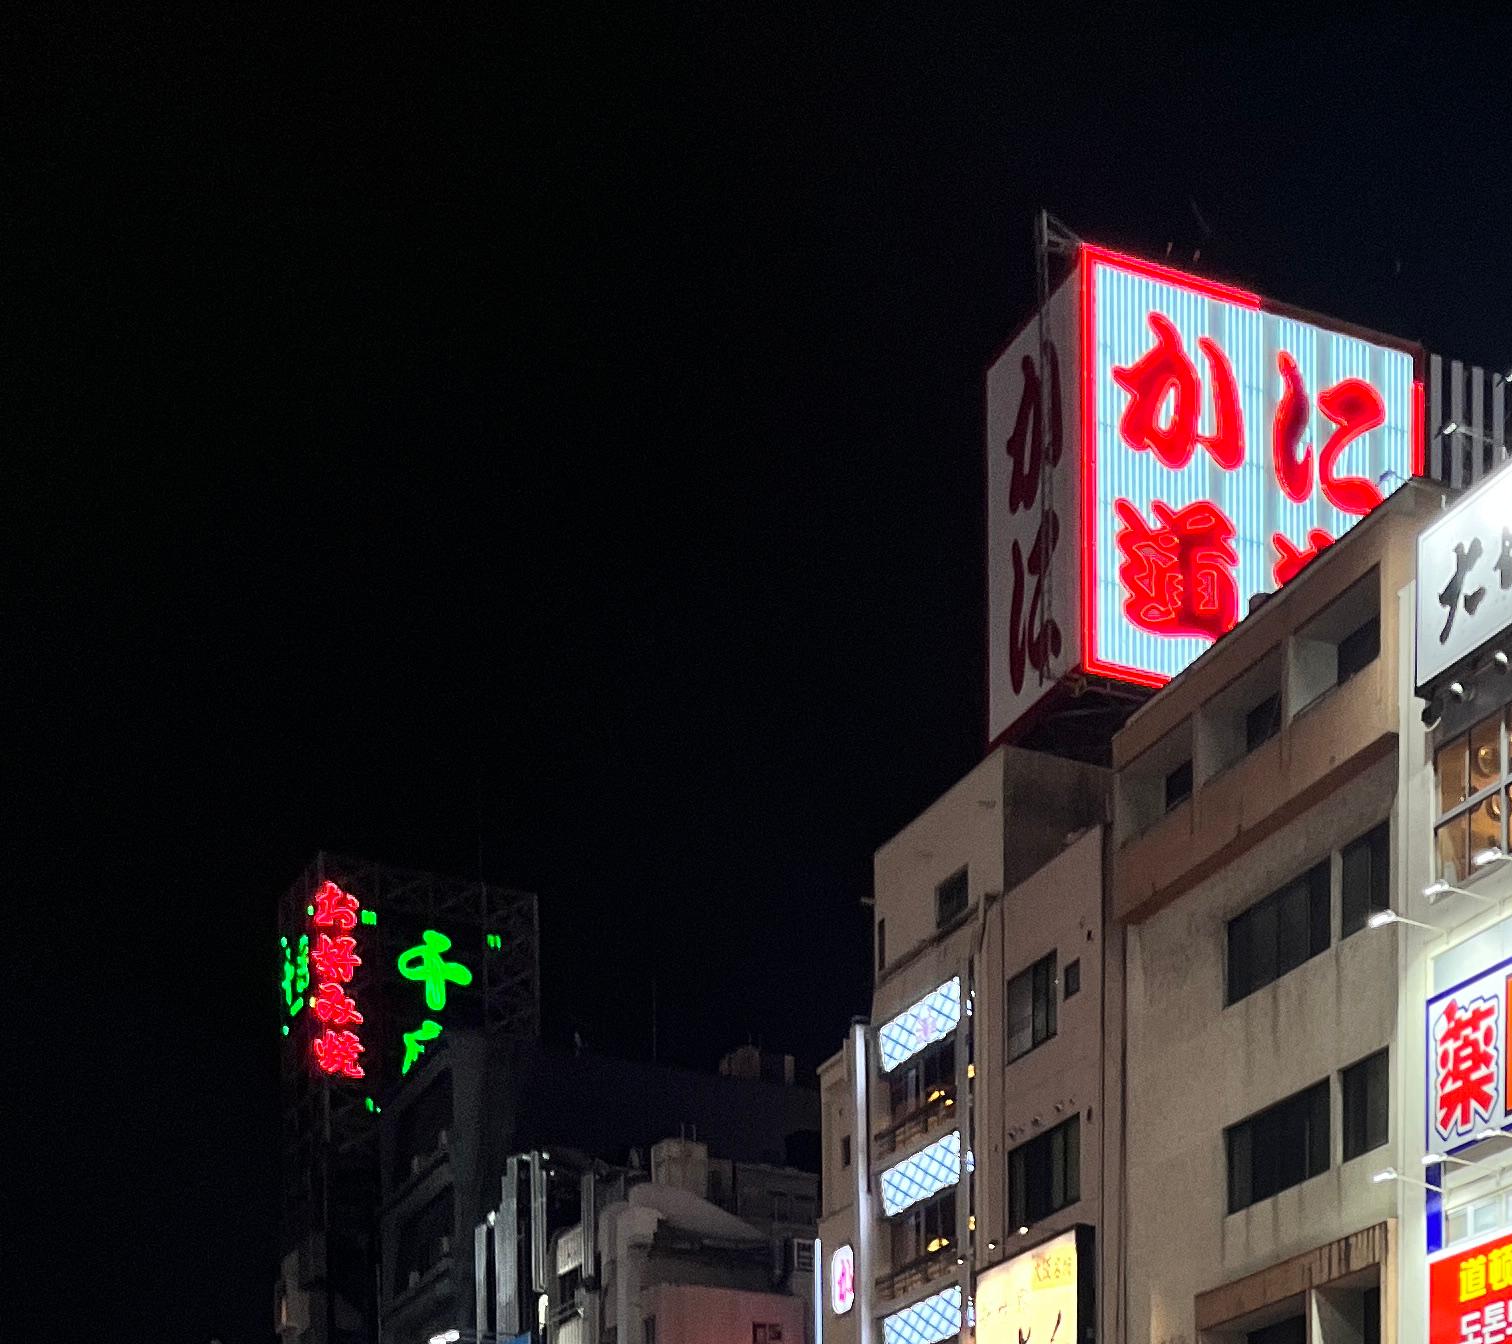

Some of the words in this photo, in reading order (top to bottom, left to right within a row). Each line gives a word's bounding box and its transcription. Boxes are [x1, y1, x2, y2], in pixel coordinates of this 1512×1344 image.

[1112, 311, 1386, 514] かに
[1114, 498, 1336, 640] 道
[398, 930, 473, 1075] 千
[1437, 998, 1498, 1140] 薬
